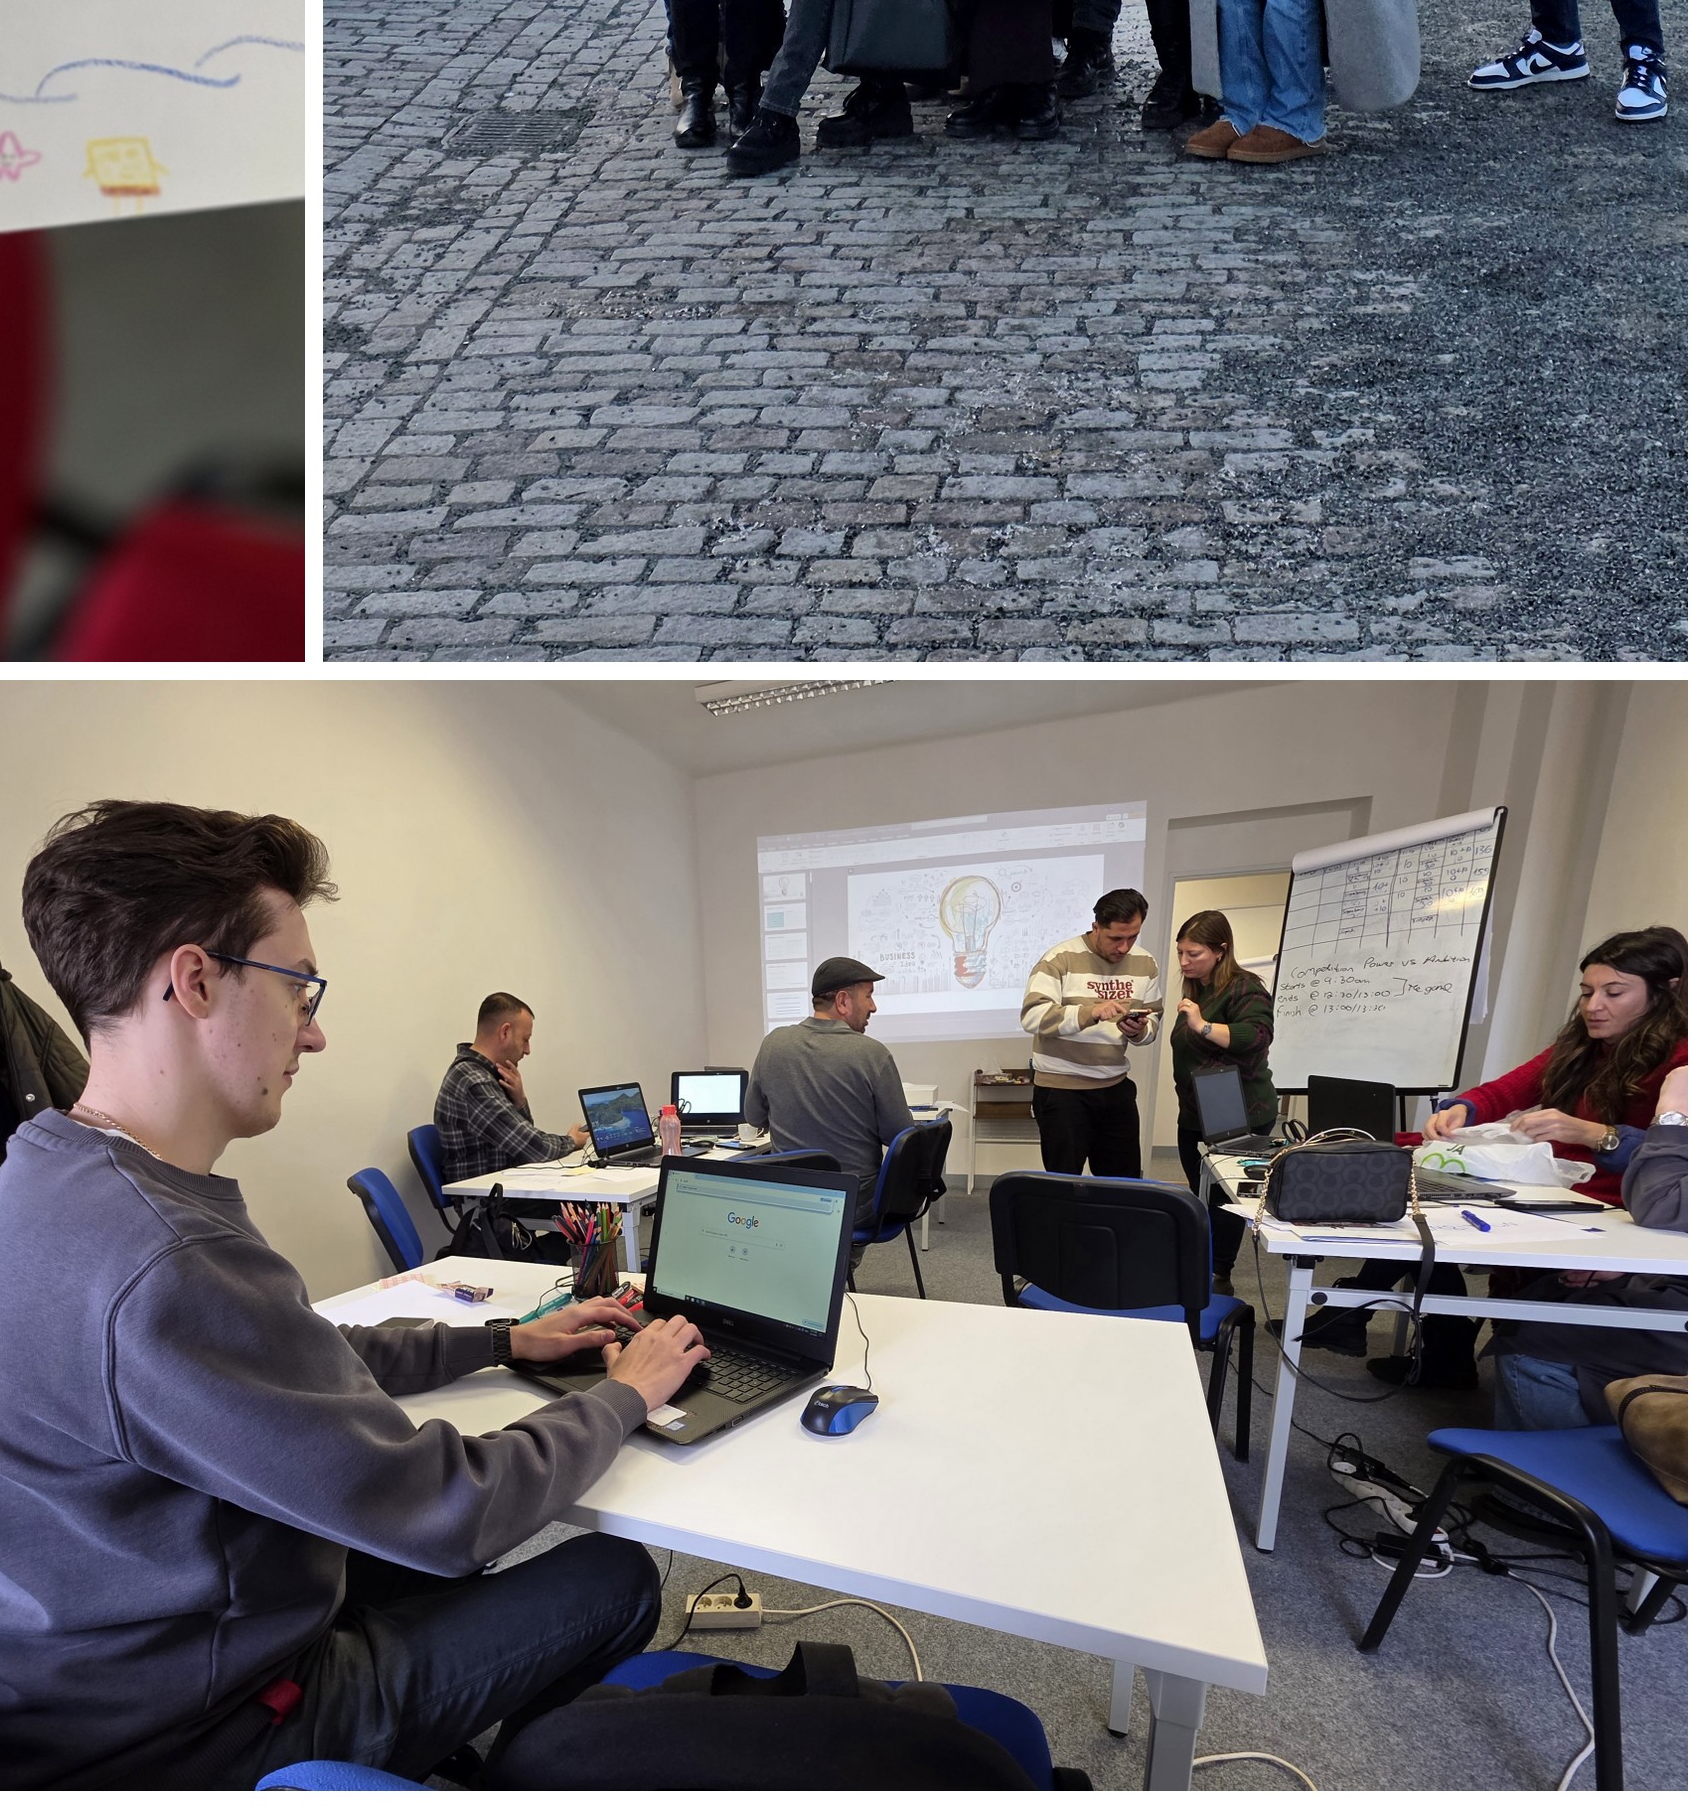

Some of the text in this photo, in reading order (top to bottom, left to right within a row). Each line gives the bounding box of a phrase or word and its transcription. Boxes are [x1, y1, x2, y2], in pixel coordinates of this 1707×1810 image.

[879, 951, 916, 962] BUSINESS
[1363, 956, 1395, 969] Power
[1310, 979, 1320, 988] @
[1097, 989, 1134, 1000] sizer
[1309, 991, 1320, 1000] @
[1308, 1004, 1319, 1017] @
[727, 1211, 759, 1229] Google
